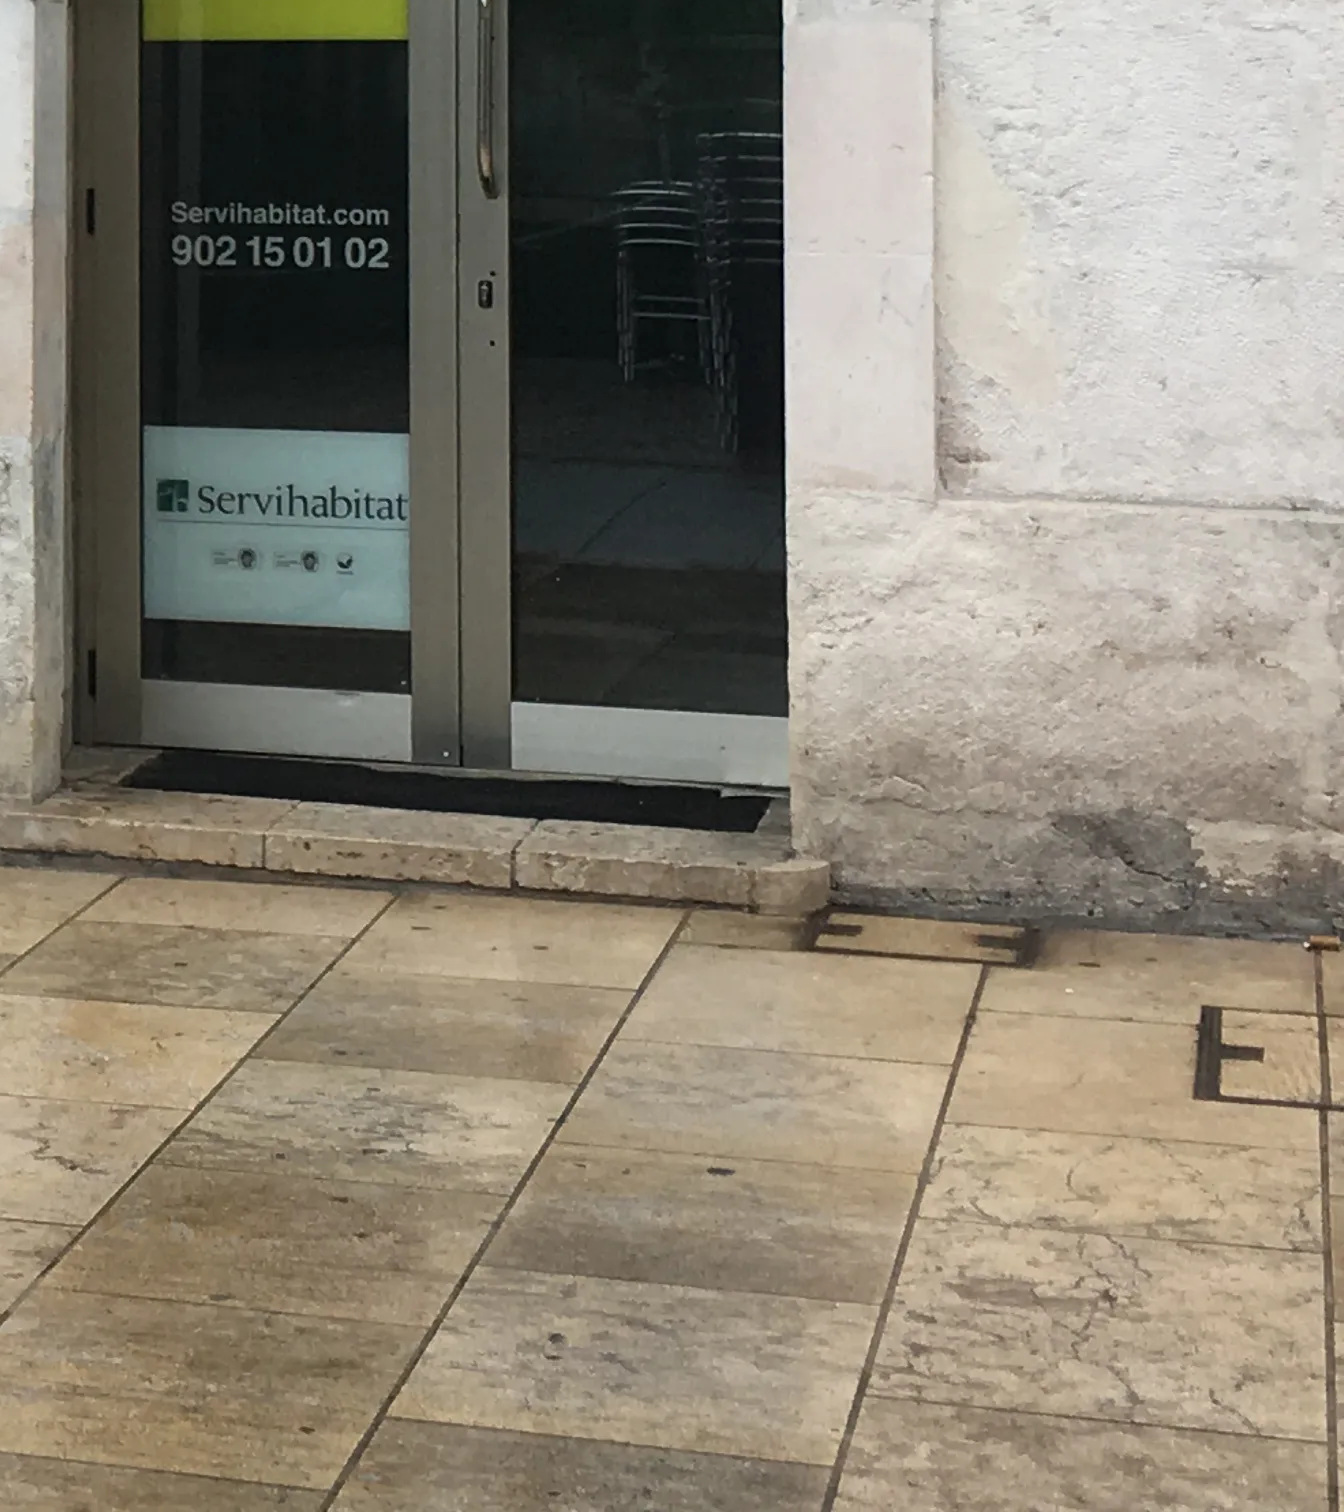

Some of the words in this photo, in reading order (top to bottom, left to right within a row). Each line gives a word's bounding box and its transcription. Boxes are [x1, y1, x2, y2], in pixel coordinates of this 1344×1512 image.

[170, 199, 390, 227] Servihabitat.com
[171, 235, 238, 267] 902
[245, 236, 285, 269] 15
[293, 236, 334, 270] 01
[344, 236, 390, 269] 02
[197, 483, 409, 522] Servihabitat
